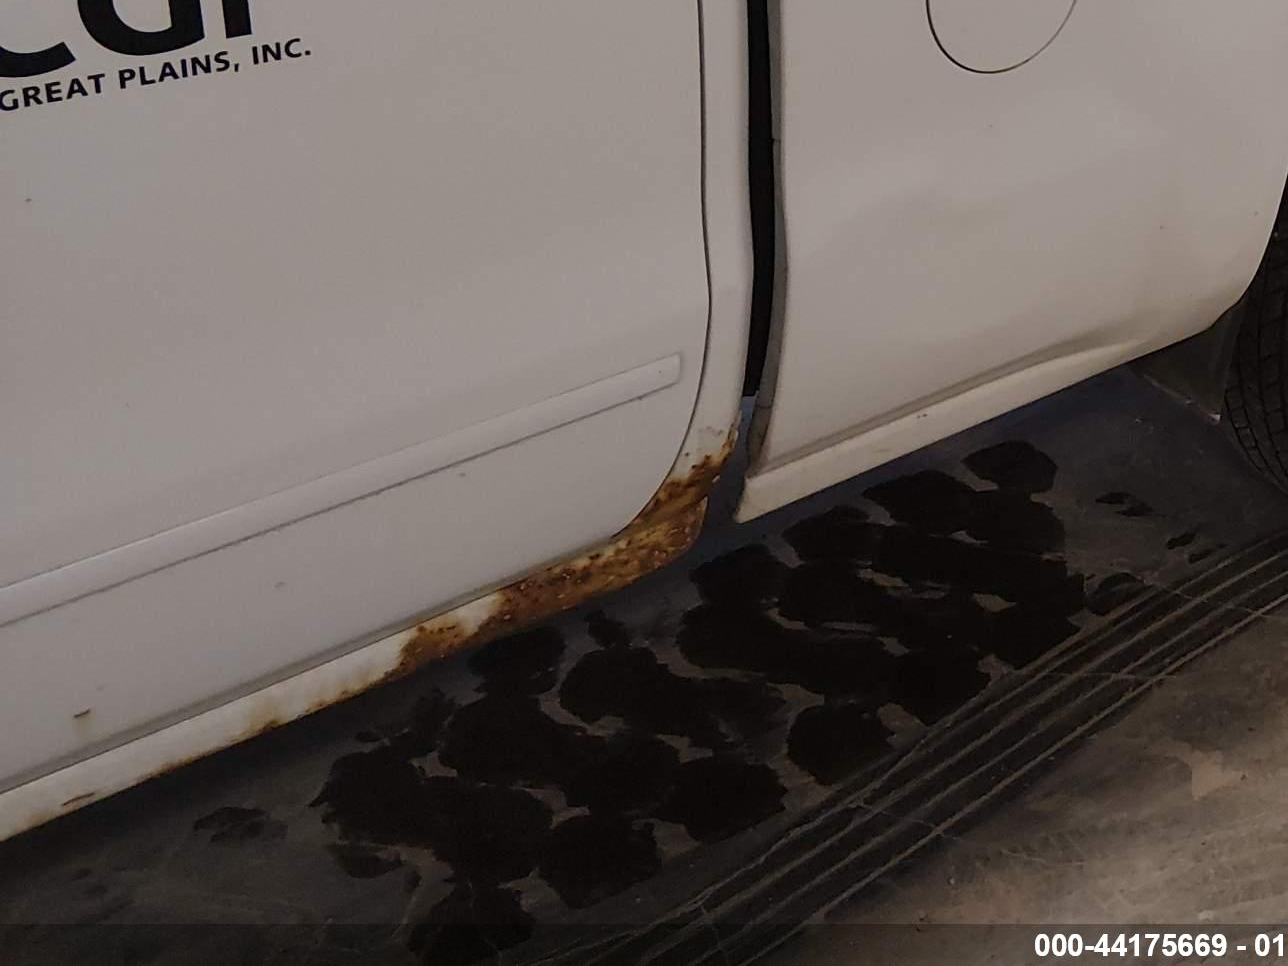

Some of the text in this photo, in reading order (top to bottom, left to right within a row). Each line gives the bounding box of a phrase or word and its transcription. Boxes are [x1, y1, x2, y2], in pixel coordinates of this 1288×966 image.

[0, 38, 312, 111] GREAT PLAINS, INC.
